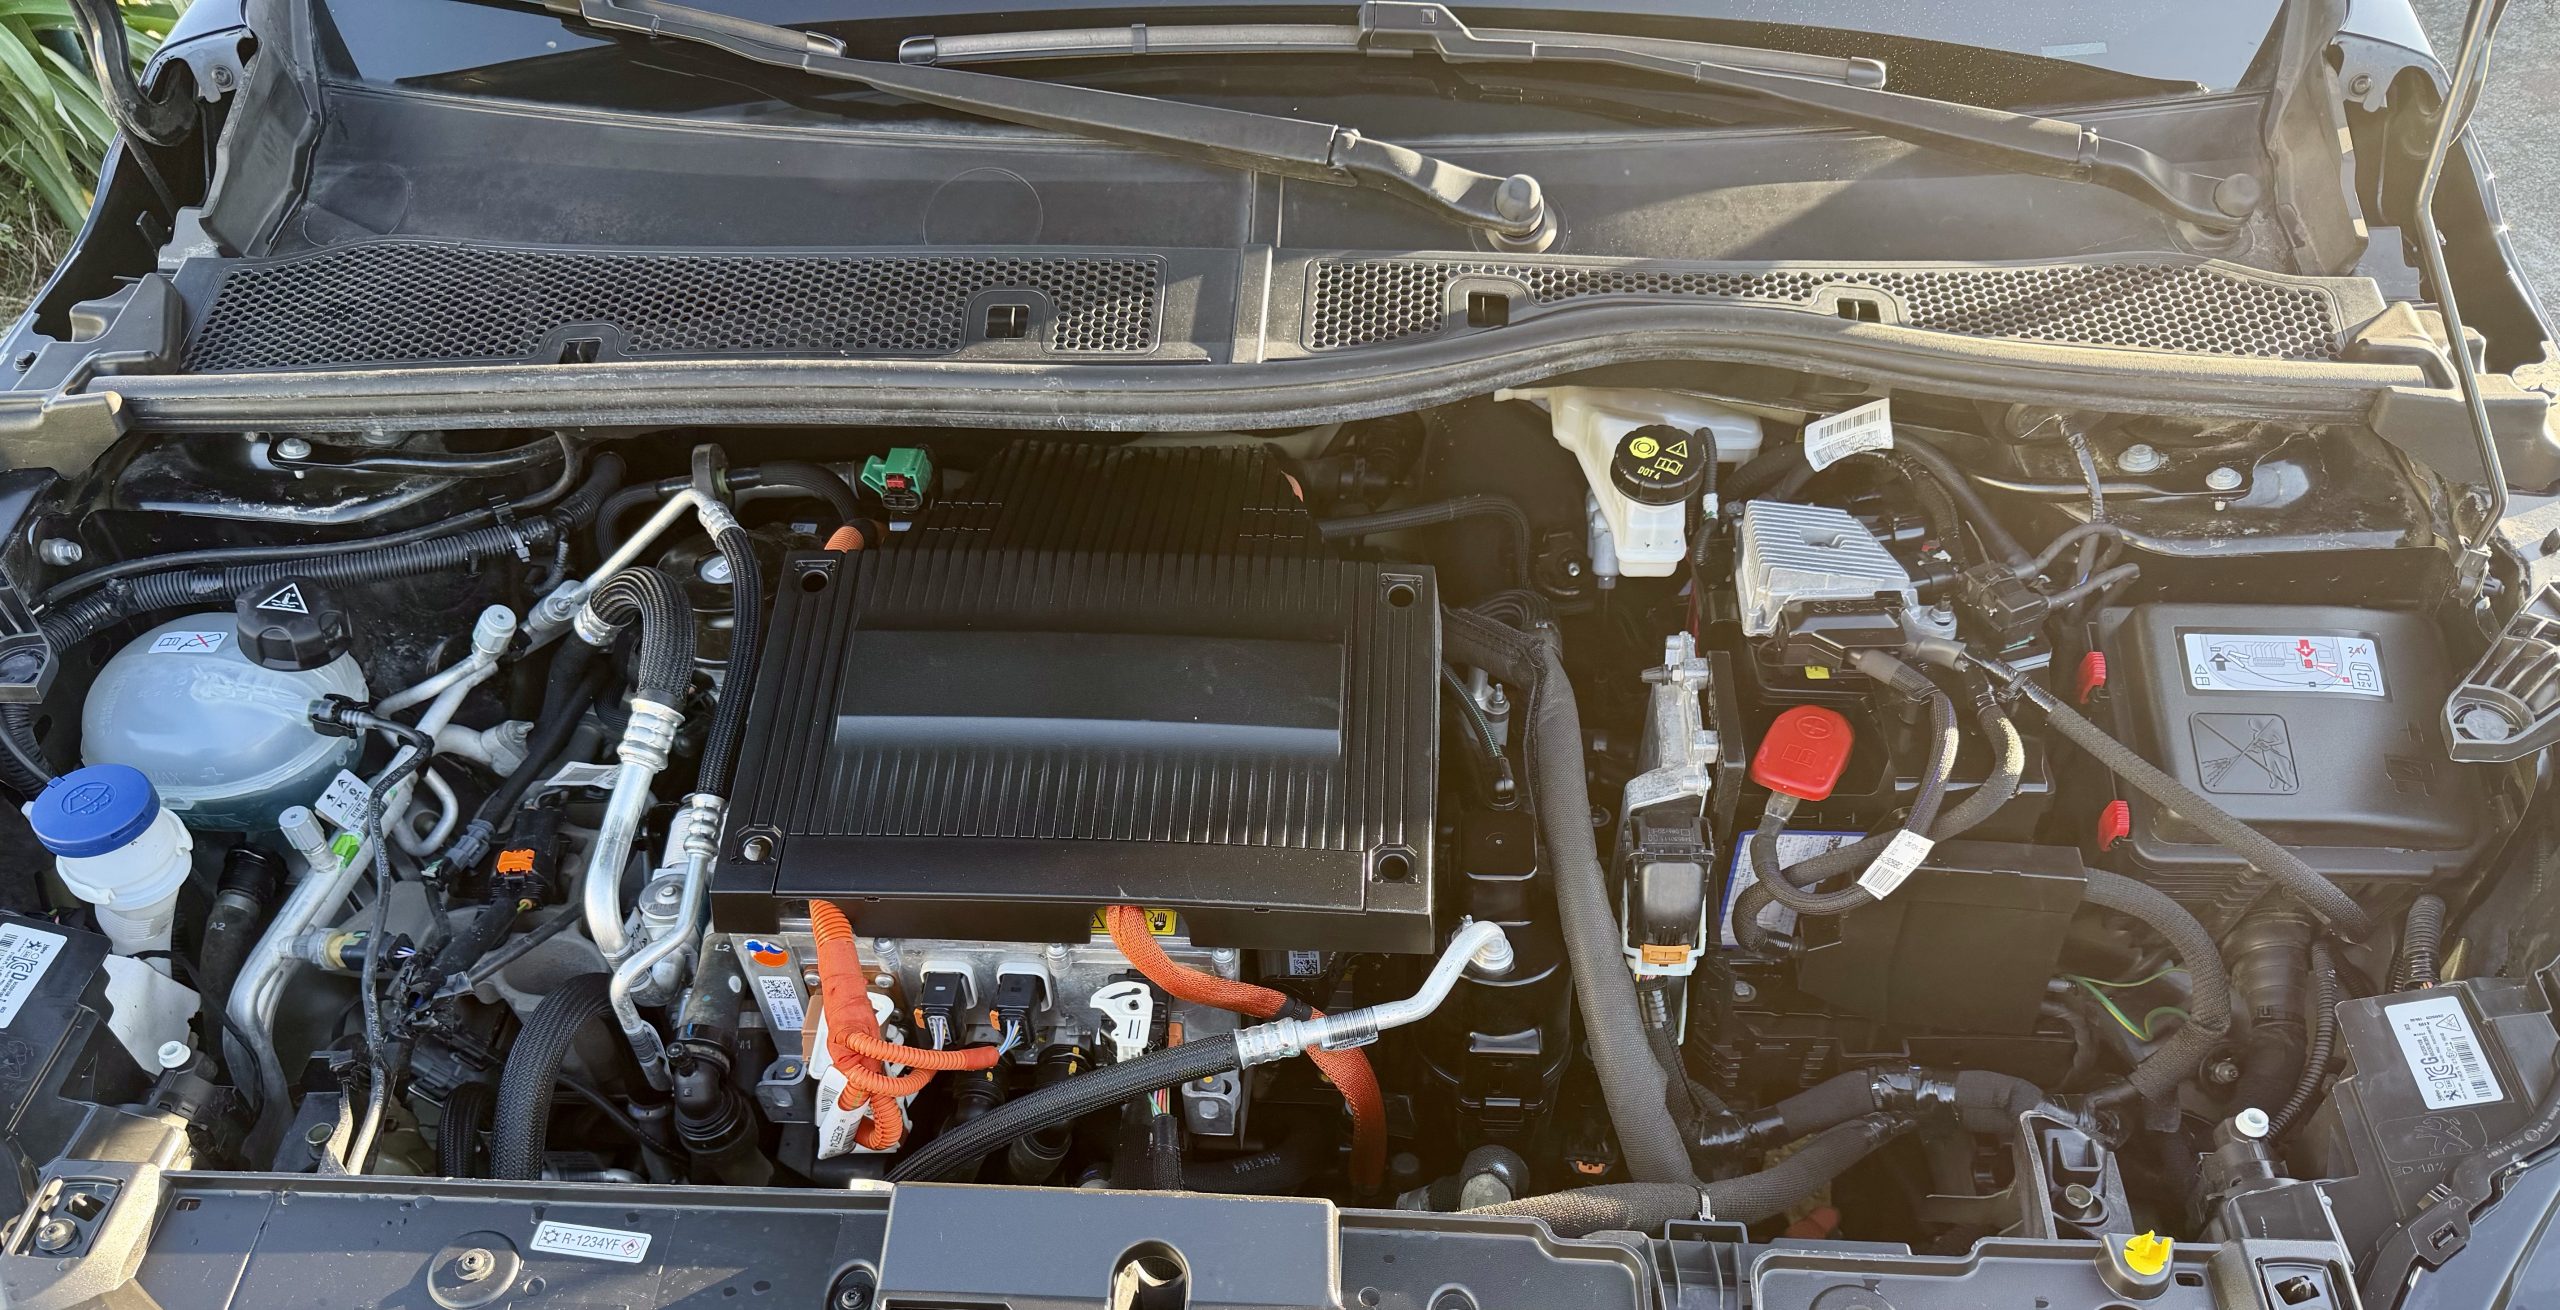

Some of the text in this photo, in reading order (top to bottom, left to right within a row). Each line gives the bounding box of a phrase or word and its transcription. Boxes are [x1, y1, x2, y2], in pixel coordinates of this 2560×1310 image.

[1637, 466, 1661, 480] DOT 4
[209, 921, 226, 931] A2
[714, 943, 731, 952] L2
[561, 1232, 621, 1250] R-1234YF
